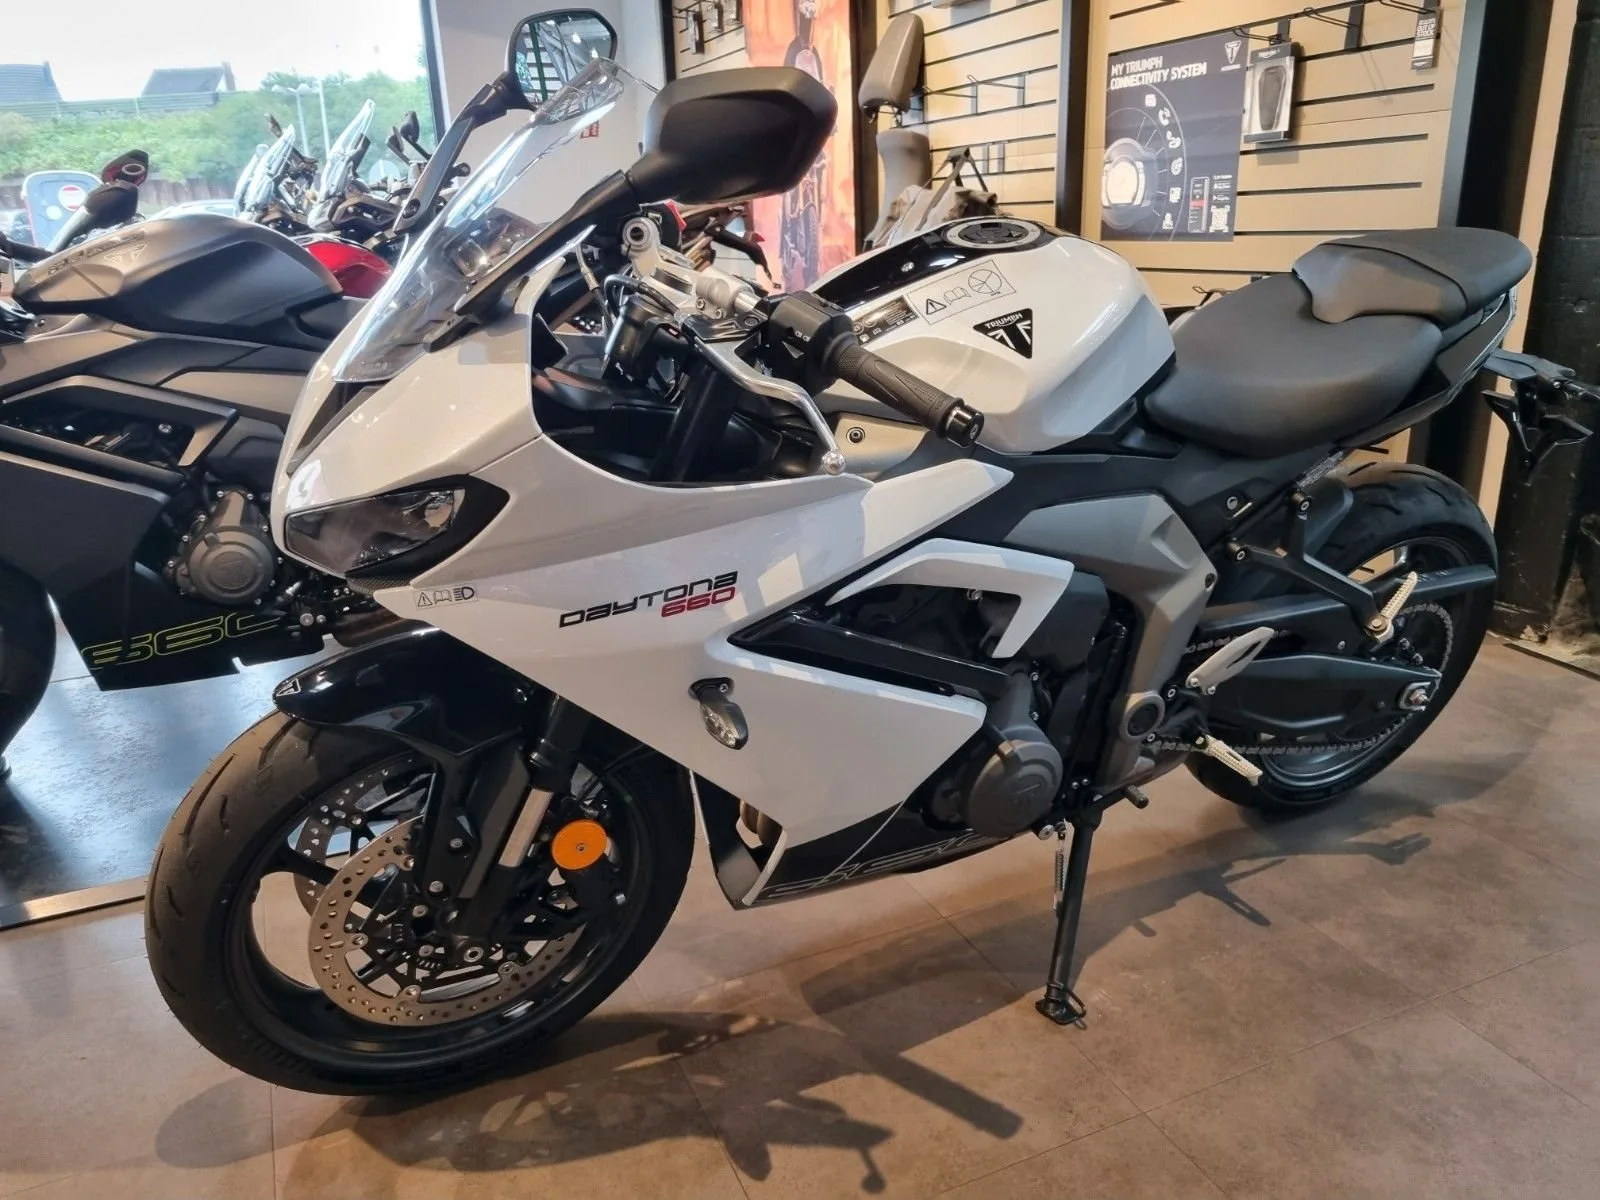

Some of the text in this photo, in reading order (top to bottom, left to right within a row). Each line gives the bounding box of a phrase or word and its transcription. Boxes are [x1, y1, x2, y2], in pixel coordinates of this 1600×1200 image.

[1110, 68, 1169, 90] CONNECTIVITY
[1171, 62, 1207, 80] SYSTEM
[1111, 55, 1163, 77] MY TRIUMPH
[984, 312, 1023, 329] TRIUMPH
[661, 586, 736, 618] 660
